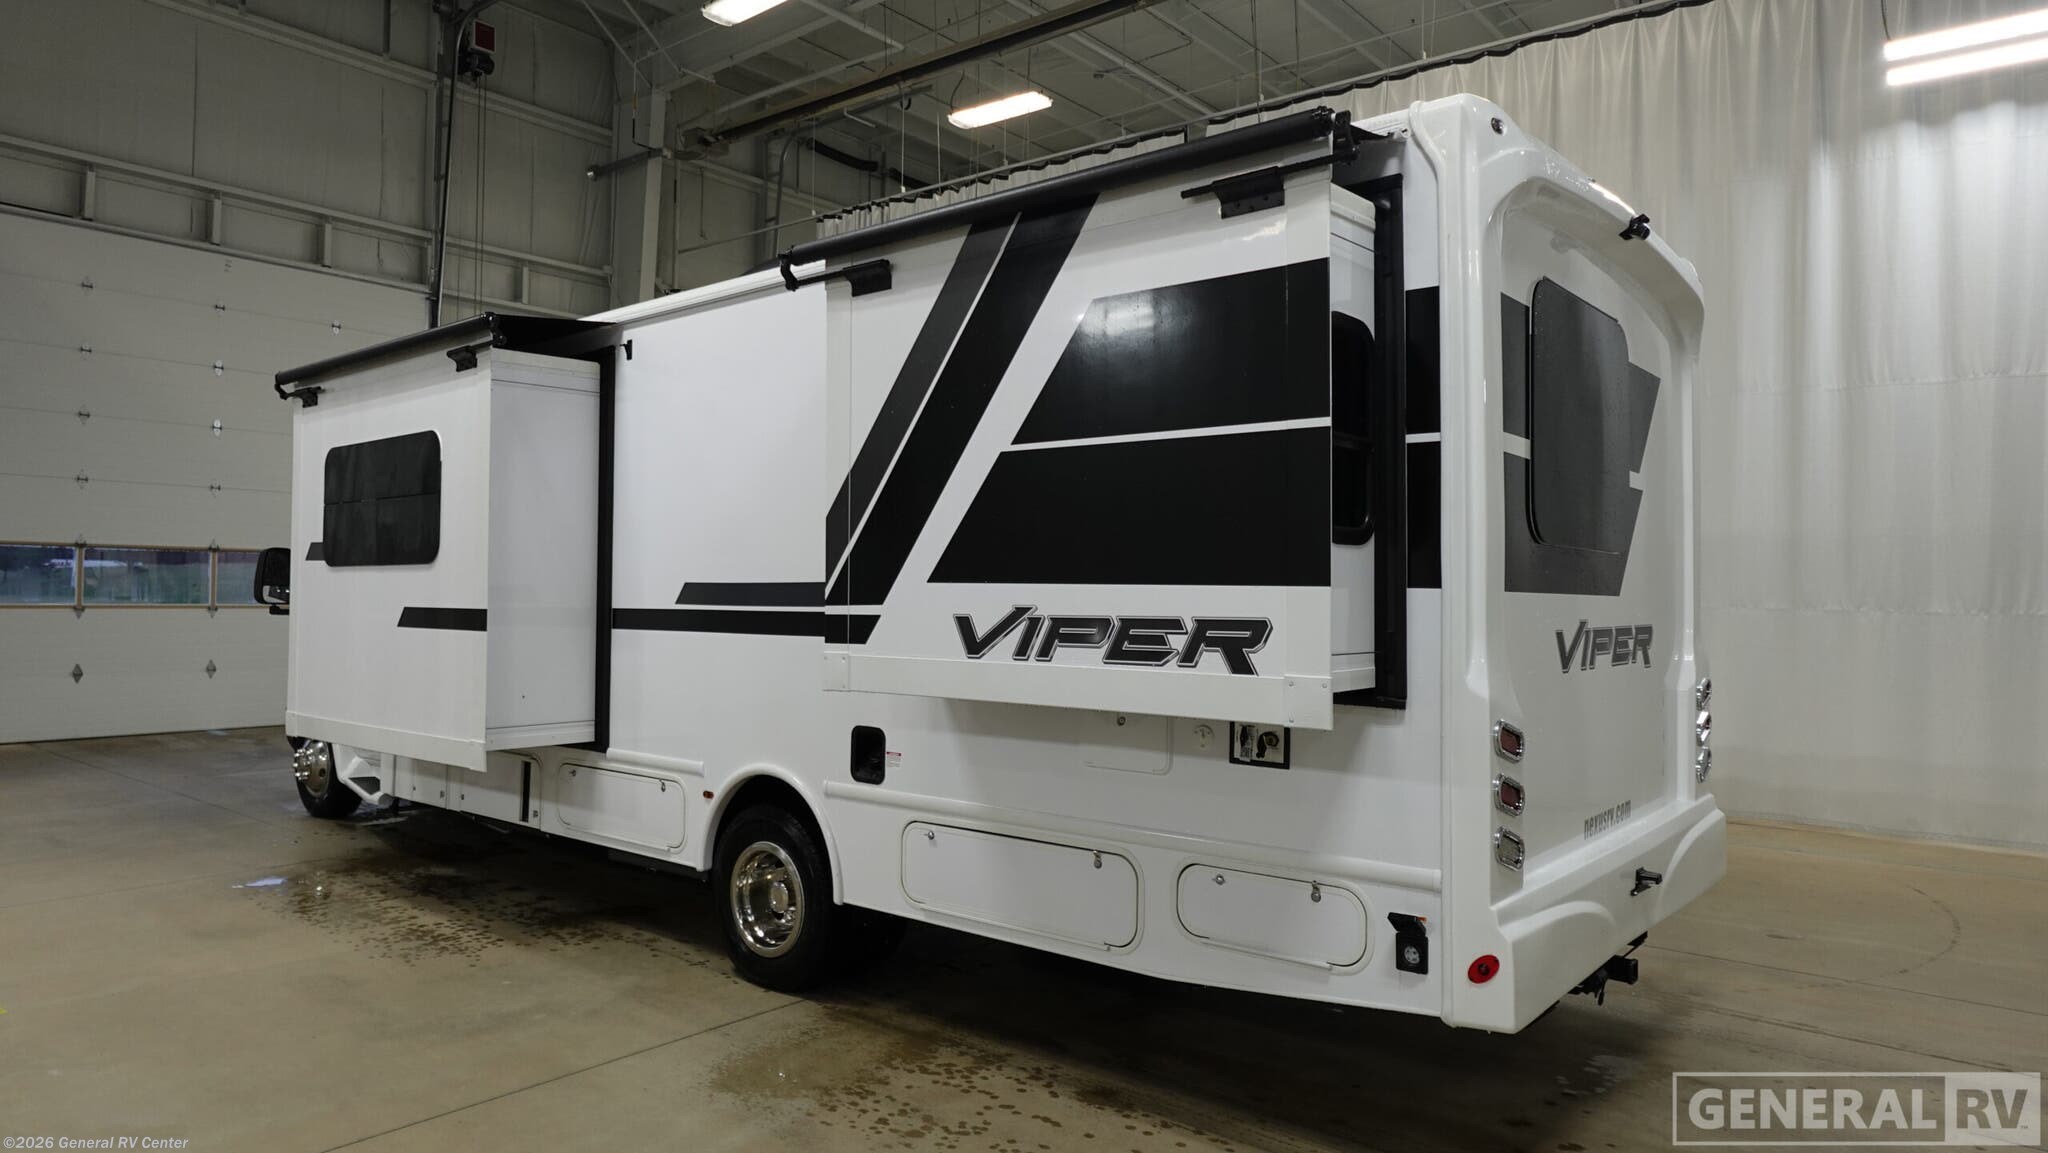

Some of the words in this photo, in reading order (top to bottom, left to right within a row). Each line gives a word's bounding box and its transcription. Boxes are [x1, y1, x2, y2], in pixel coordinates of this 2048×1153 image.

[953, 606, 1273, 676] VIPER
[1555, 619, 1653, 673] VIPER
[1584, 800, 1631, 840] nexusrv.com
